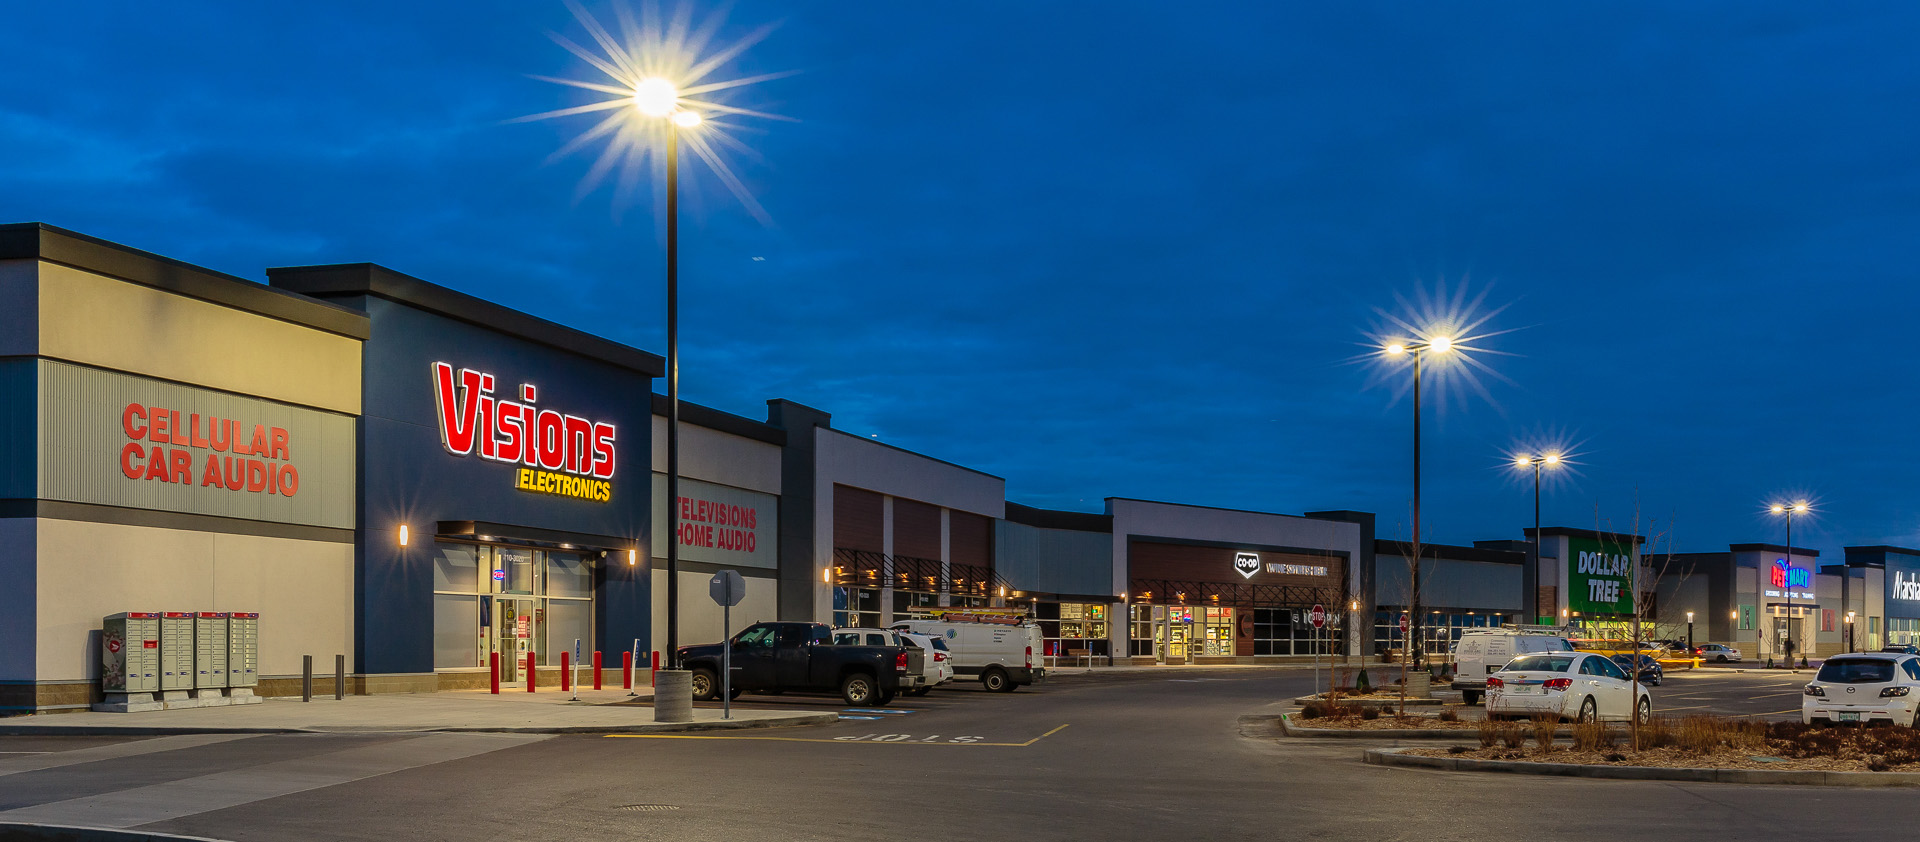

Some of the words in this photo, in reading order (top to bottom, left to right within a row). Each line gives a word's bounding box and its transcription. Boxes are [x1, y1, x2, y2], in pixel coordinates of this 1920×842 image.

[122, 402, 290, 461] CELLULAR
[432, 361, 616, 479] Visions
[121, 442, 193, 485] CAR
[201, 453, 299, 497] AUDIO
[518, 467, 611, 502] ELECTRONICS
[717, 527, 756, 553] AUDIO
[1237, 557, 1258, 569] CO-OP
[1577, 550, 1629, 577] DOLLAR
[1588, 578, 1620, 603] TREE
[1312, 612, 1325, 621] STOP
